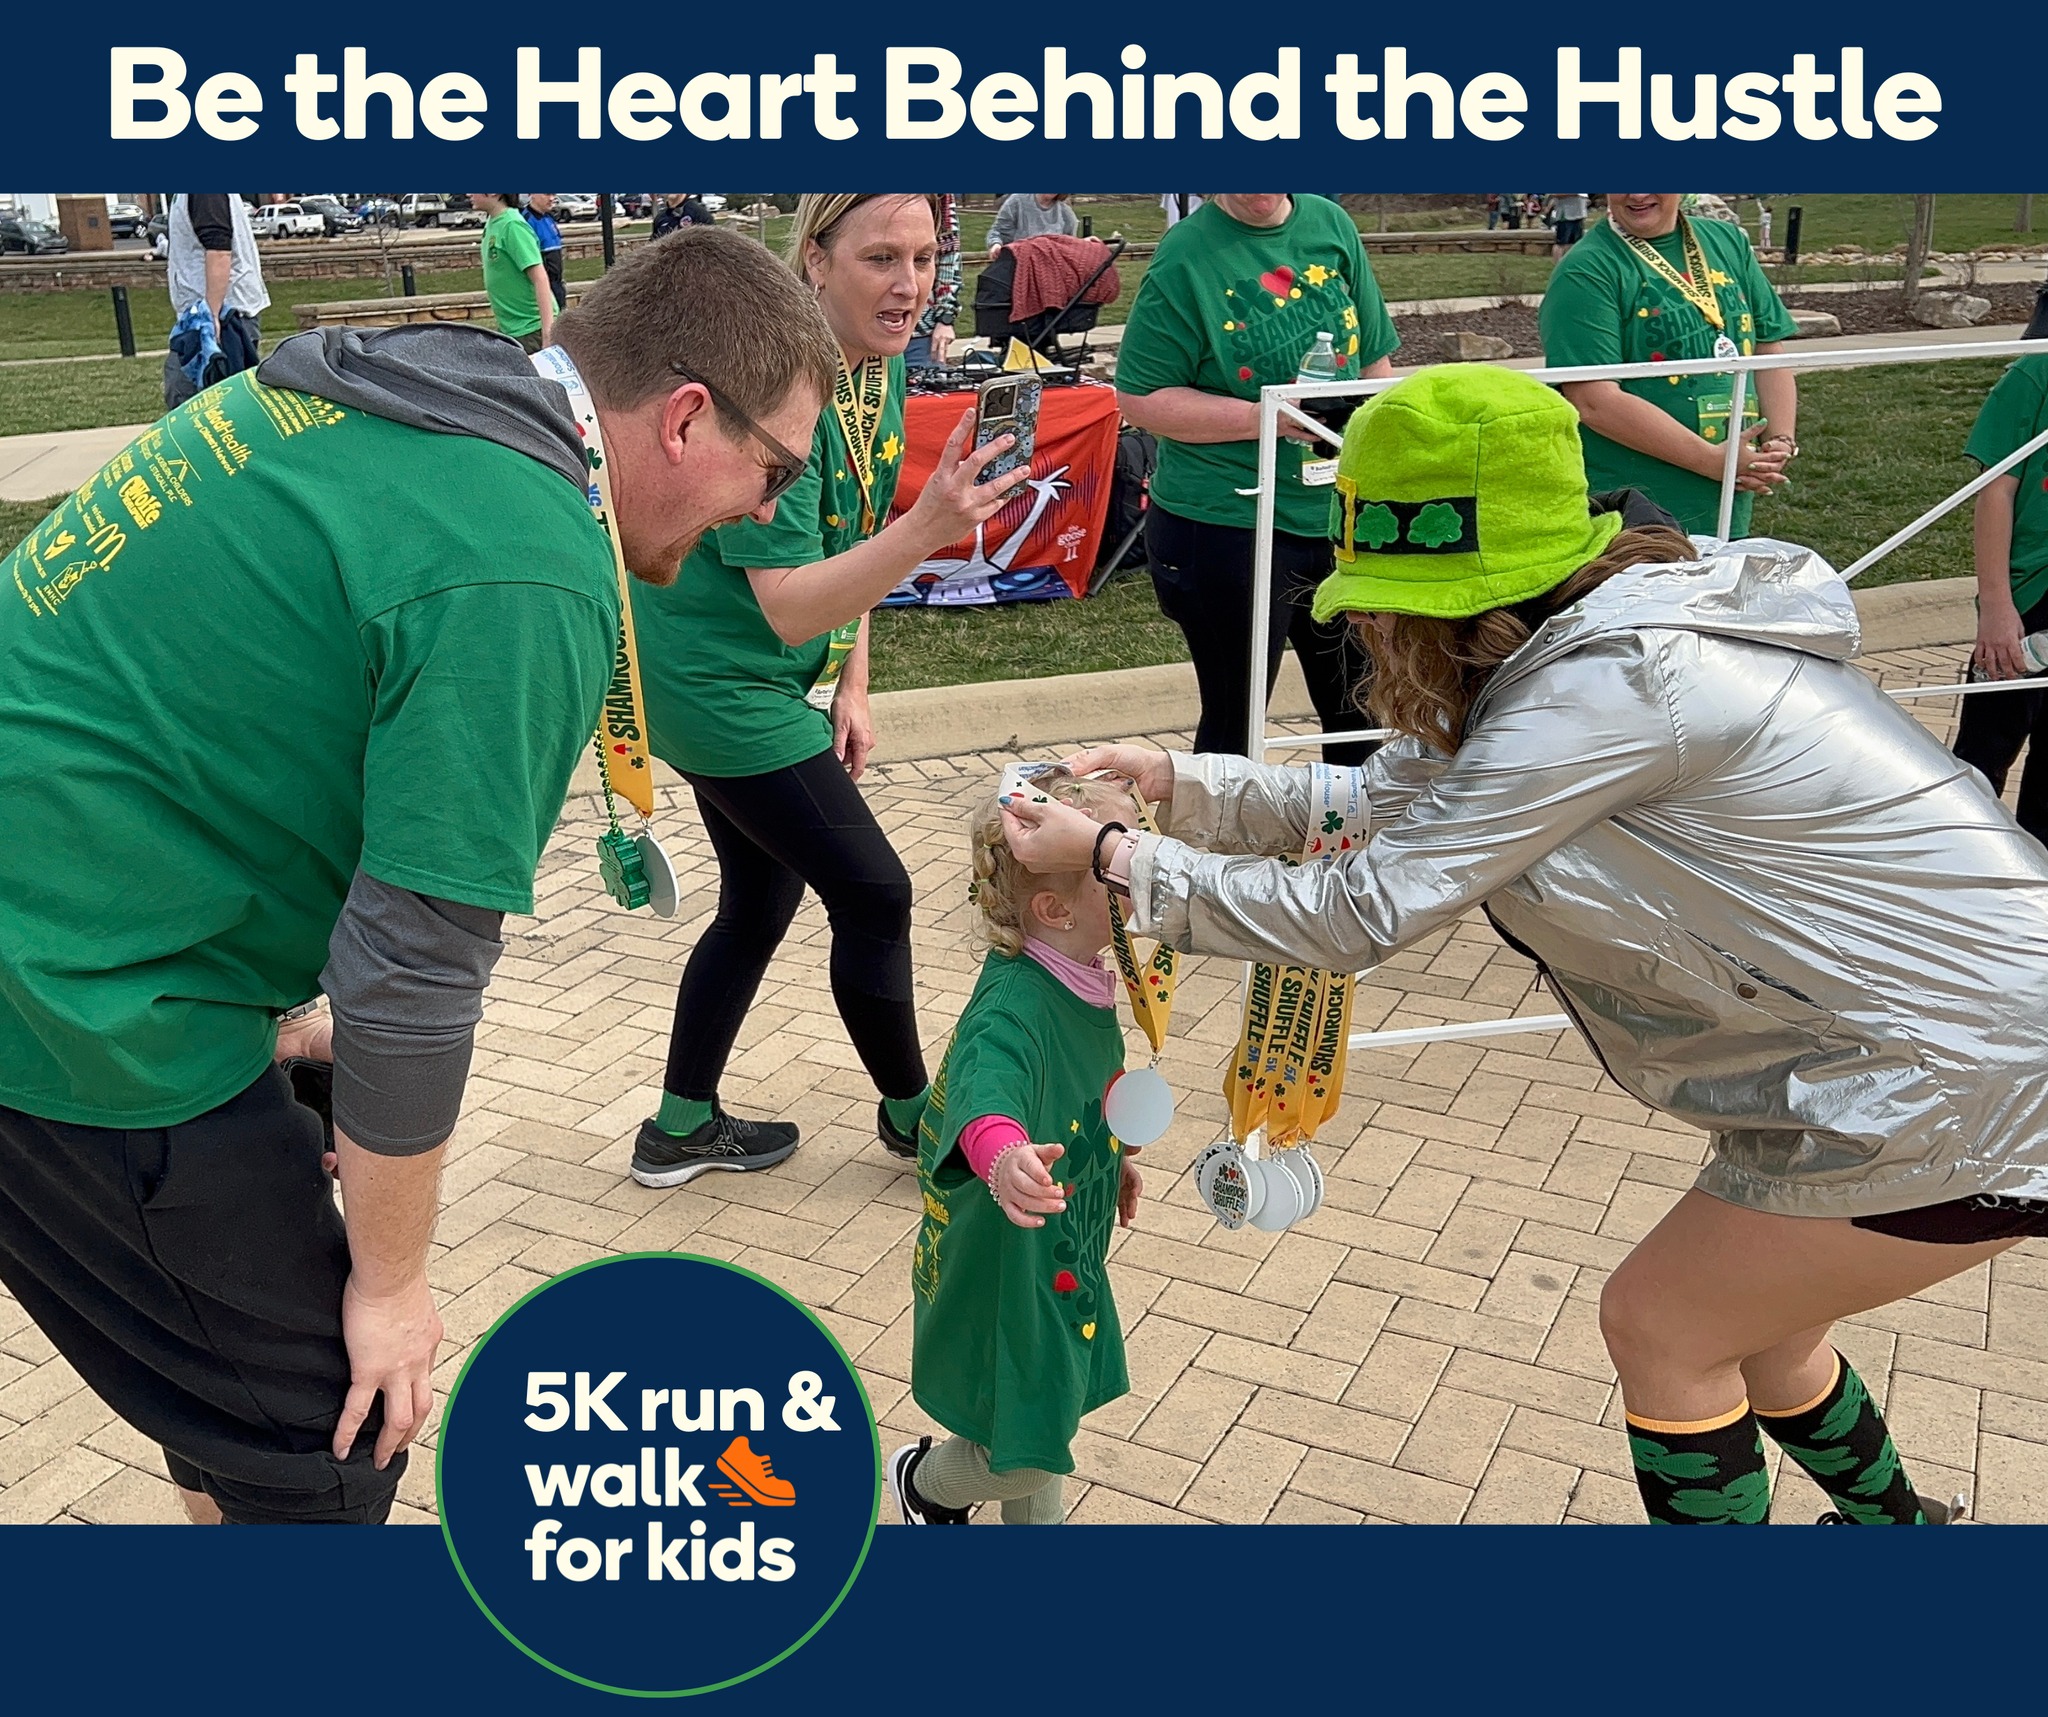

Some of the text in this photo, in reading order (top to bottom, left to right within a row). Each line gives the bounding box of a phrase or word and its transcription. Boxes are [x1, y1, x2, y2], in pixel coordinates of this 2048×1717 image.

[863, 354, 883, 410] SHUFFLE
[841, 404, 868, 481] SHAMROCK
[212, 446, 237, 476] Network
[125, 478, 162, 524] Wolfe
[165, 489, 178, 503] PLC
[169, 476, 193, 506] CHILDERS
[1057, 528, 1087, 546] goose
[605, 617, 641, 743] SHAMR
[1323, 780, 1333, 806] House
[1108, 892, 1141, 986] SHAMROC
[1247, 962, 1272, 1063] SHUFFLE 5K
[1267, 977, 1304, 1055] SHUFFLE
[1310, 982, 1346, 1076] SHAMROCK
[1265, 1056, 1278, 1073] 5K
[1284, 1063, 1297, 1086] 5K
[1213, 1178, 1247, 1202] SHAMROCK
[1214, 1194, 1240, 1213] SHUFFLE
